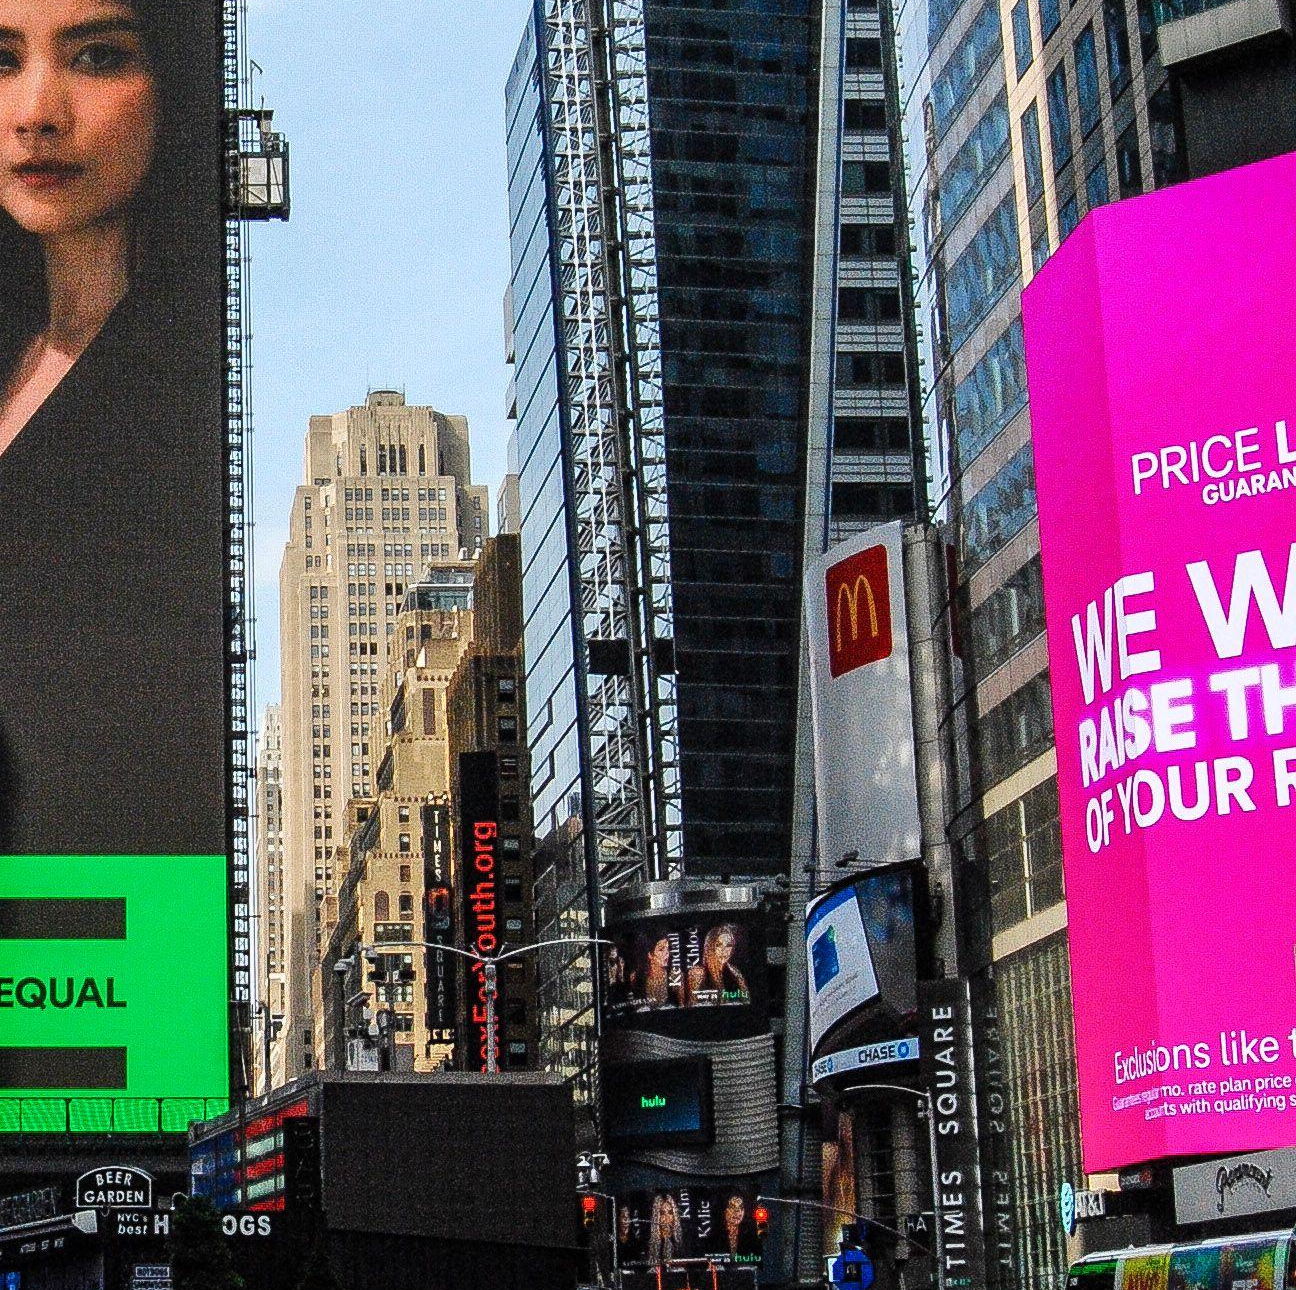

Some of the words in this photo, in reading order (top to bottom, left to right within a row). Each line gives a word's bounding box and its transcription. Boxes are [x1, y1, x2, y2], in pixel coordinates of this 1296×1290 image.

[1131, 427, 1261, 496] PRICE
[1071, 571, 1162, 706] WE
[1185, 543, 1296, 660] W
[1078, 676, 1199, 789] RAISE
[1086, 789, 1115, 854] OF
[1115, 754, 1256, 836] YOUR
[667, 932, 682, 988] Kendall
[721, 988, 749, 1000] hulu
[858, 1045, 896, 1065] CHASE
[1114, 1040, 1211, 1085] Exclusions
[1220, 1029, 1280, 1067] like
[933, 1005, 959, 1135] SQUARE
[1161, 1085, 1185, 1098] mo.
[1188, 1081, 1217, 1096] rate
[1220, 1077, 1252, 1096] plan
[1255, 1074, 1292, 1093] price
[640, 1095, 667, 1109] hulu
[1179, 1098, 1212, 1115] with
[1214, 1093, 1286, 1115] qualifying
[95, 1171, 132, 1187] BEER
[83, 1189, 145, 1204] GARDEN
[117, 1223, 148, 1235] best
[221, 1214, 272, 1236] OGS
[941, 1169, 968, 1270] TIMES
[734, 1253, 762, 1263] hulu
